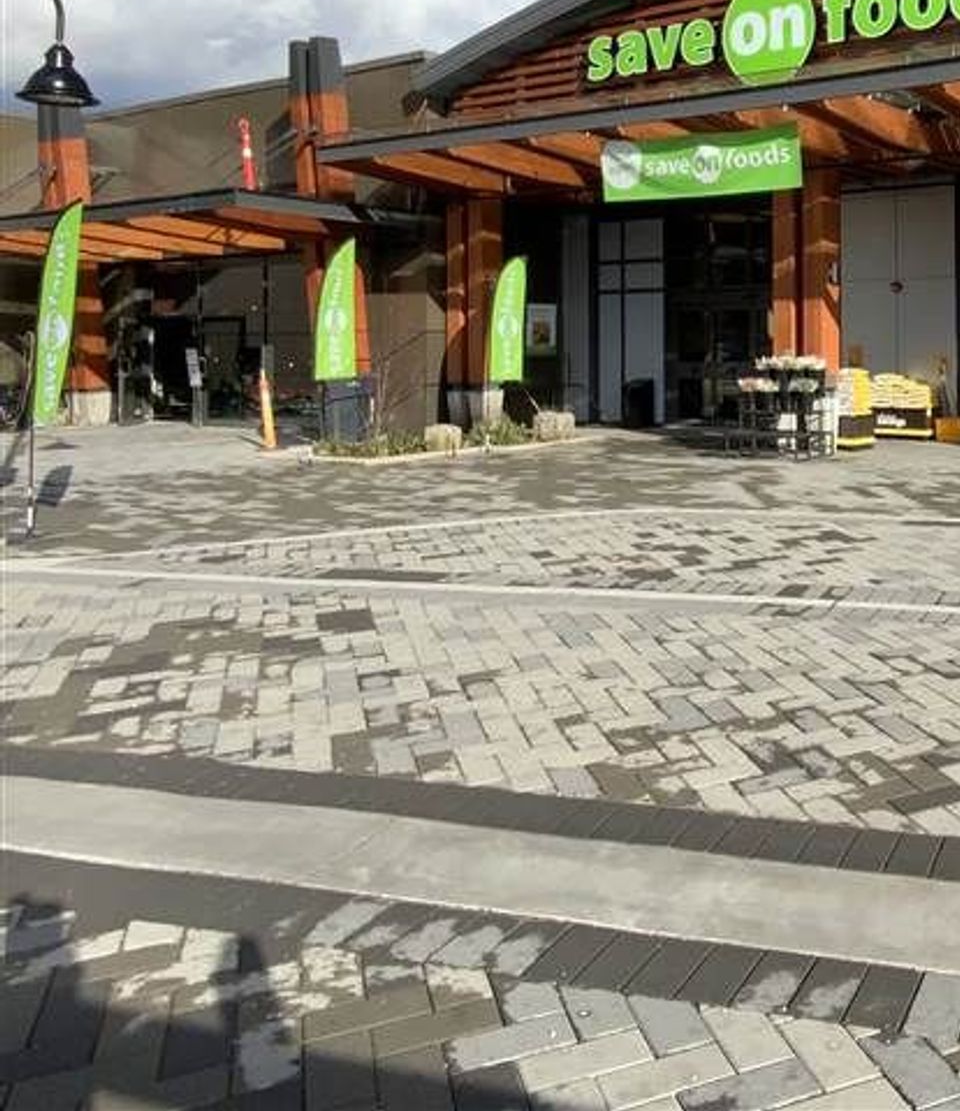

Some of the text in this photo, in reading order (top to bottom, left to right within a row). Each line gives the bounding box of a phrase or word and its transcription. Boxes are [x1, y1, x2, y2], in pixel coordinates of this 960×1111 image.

[587, 18, 716, 82] save
[731, 3, 806, 56] on
[644, 156, 690, 177] save
[725, 140, 791, 169] foods
